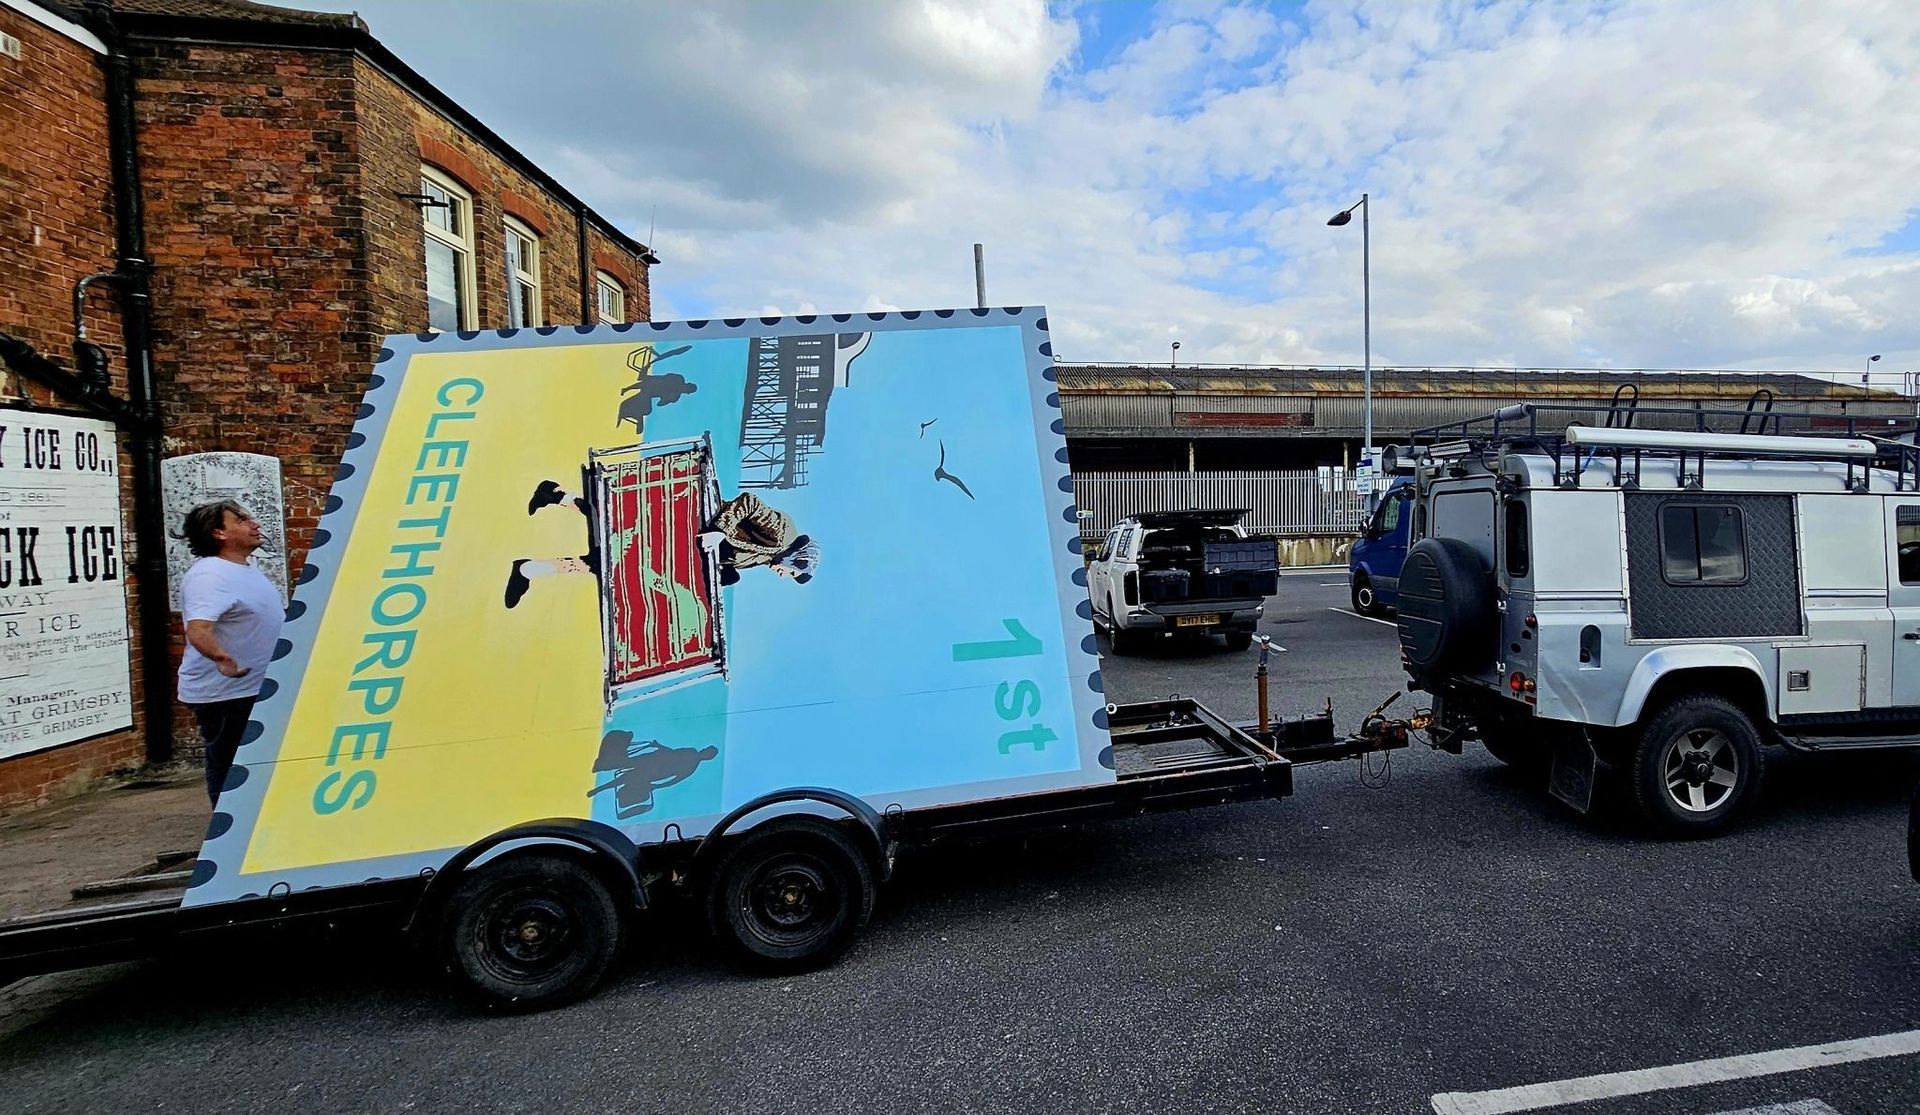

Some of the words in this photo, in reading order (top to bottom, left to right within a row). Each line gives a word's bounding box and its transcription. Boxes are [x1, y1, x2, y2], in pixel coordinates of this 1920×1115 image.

[23, 427, 61, 470] ICE
[75, 431, 113, 477] CO.,
[0, 526, 42, 589] CK
[65, 525, 117, 583] ICE
[313, 377, 485, 815] CLEETHORPES
[5, 621, 20, 638] R
[39, 614, 82, 634] ICE
[6, 689, 78, 708] Manager.
[32, 691, 126, 720] GRIMSBY.
[952, 618, 1058, 754] 1st
